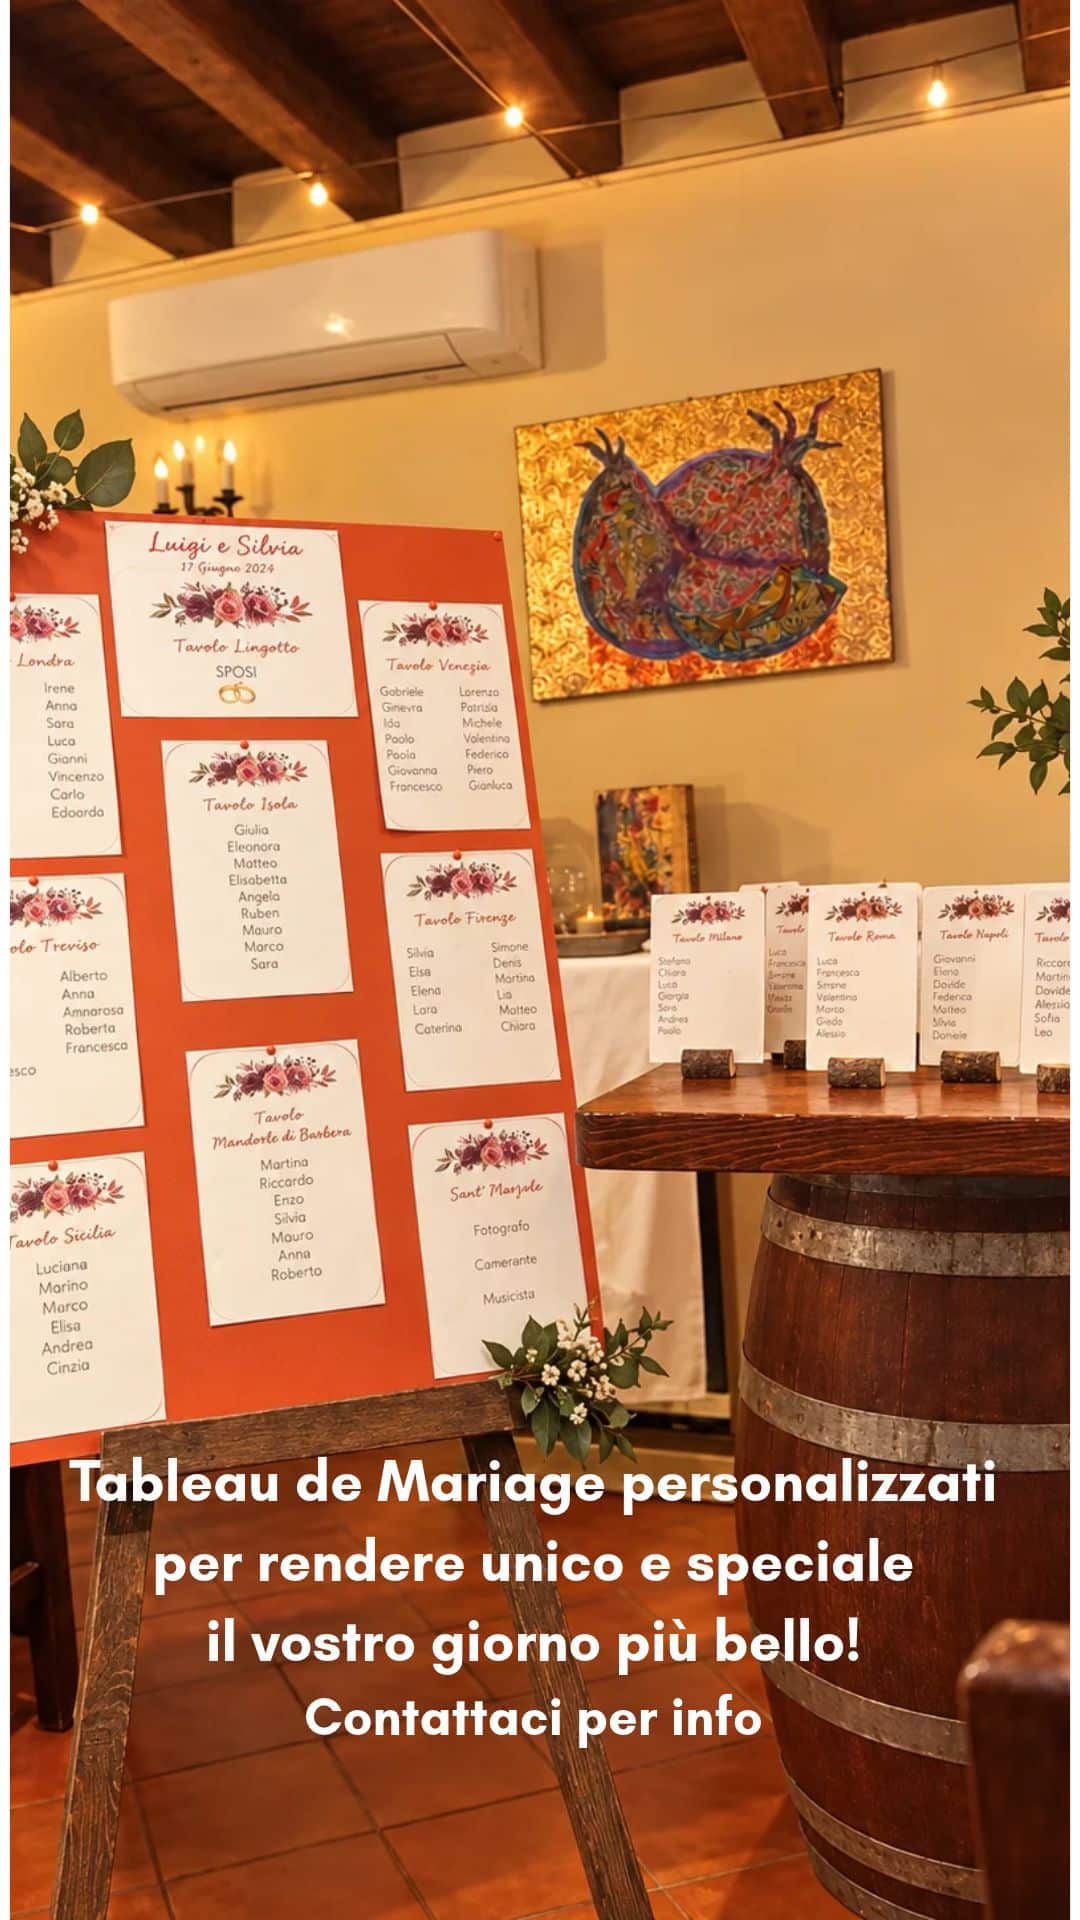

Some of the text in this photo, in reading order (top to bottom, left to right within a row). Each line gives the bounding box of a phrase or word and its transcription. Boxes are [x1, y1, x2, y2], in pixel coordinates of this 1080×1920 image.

[149, 531, 304, 560] Luigi e Silvia
[181, 561, 275, 577] 17 Giugno 2024
[173, 638, 300, 658] Tavolo Lingotto
[17, 653, 75, 668] Londra
[386, 657, 433, 671] Tavolo
[216, 665, 257, 679] SPOSI
[44, 682, 75, 694] Irene
[45, 700, 78, 712] Anna
[47, 735, 76, 747] Luca
[48, 752, 88, 764] Gianni
[48, 771, 104, 782] Vincenzo
[203, 796, 298, 811] Tavolo Isola
[241, 907, 280, 919] Ruben
[414, 912, 462, 927] Tavolo
[40, 938, 100, 953] Treviso
[59, 970, 108, 982] Alberto
[1035, 972, 1070, 982] Martin
[61, 988, 95, 1000] Anna
[253, 1107, 305, 1125] Tavolo
[281, 1128, 296, 1142] di
[64, 1224, 118, 1245] Sicilia
[483, 1289, 536, 1306] Musicista
